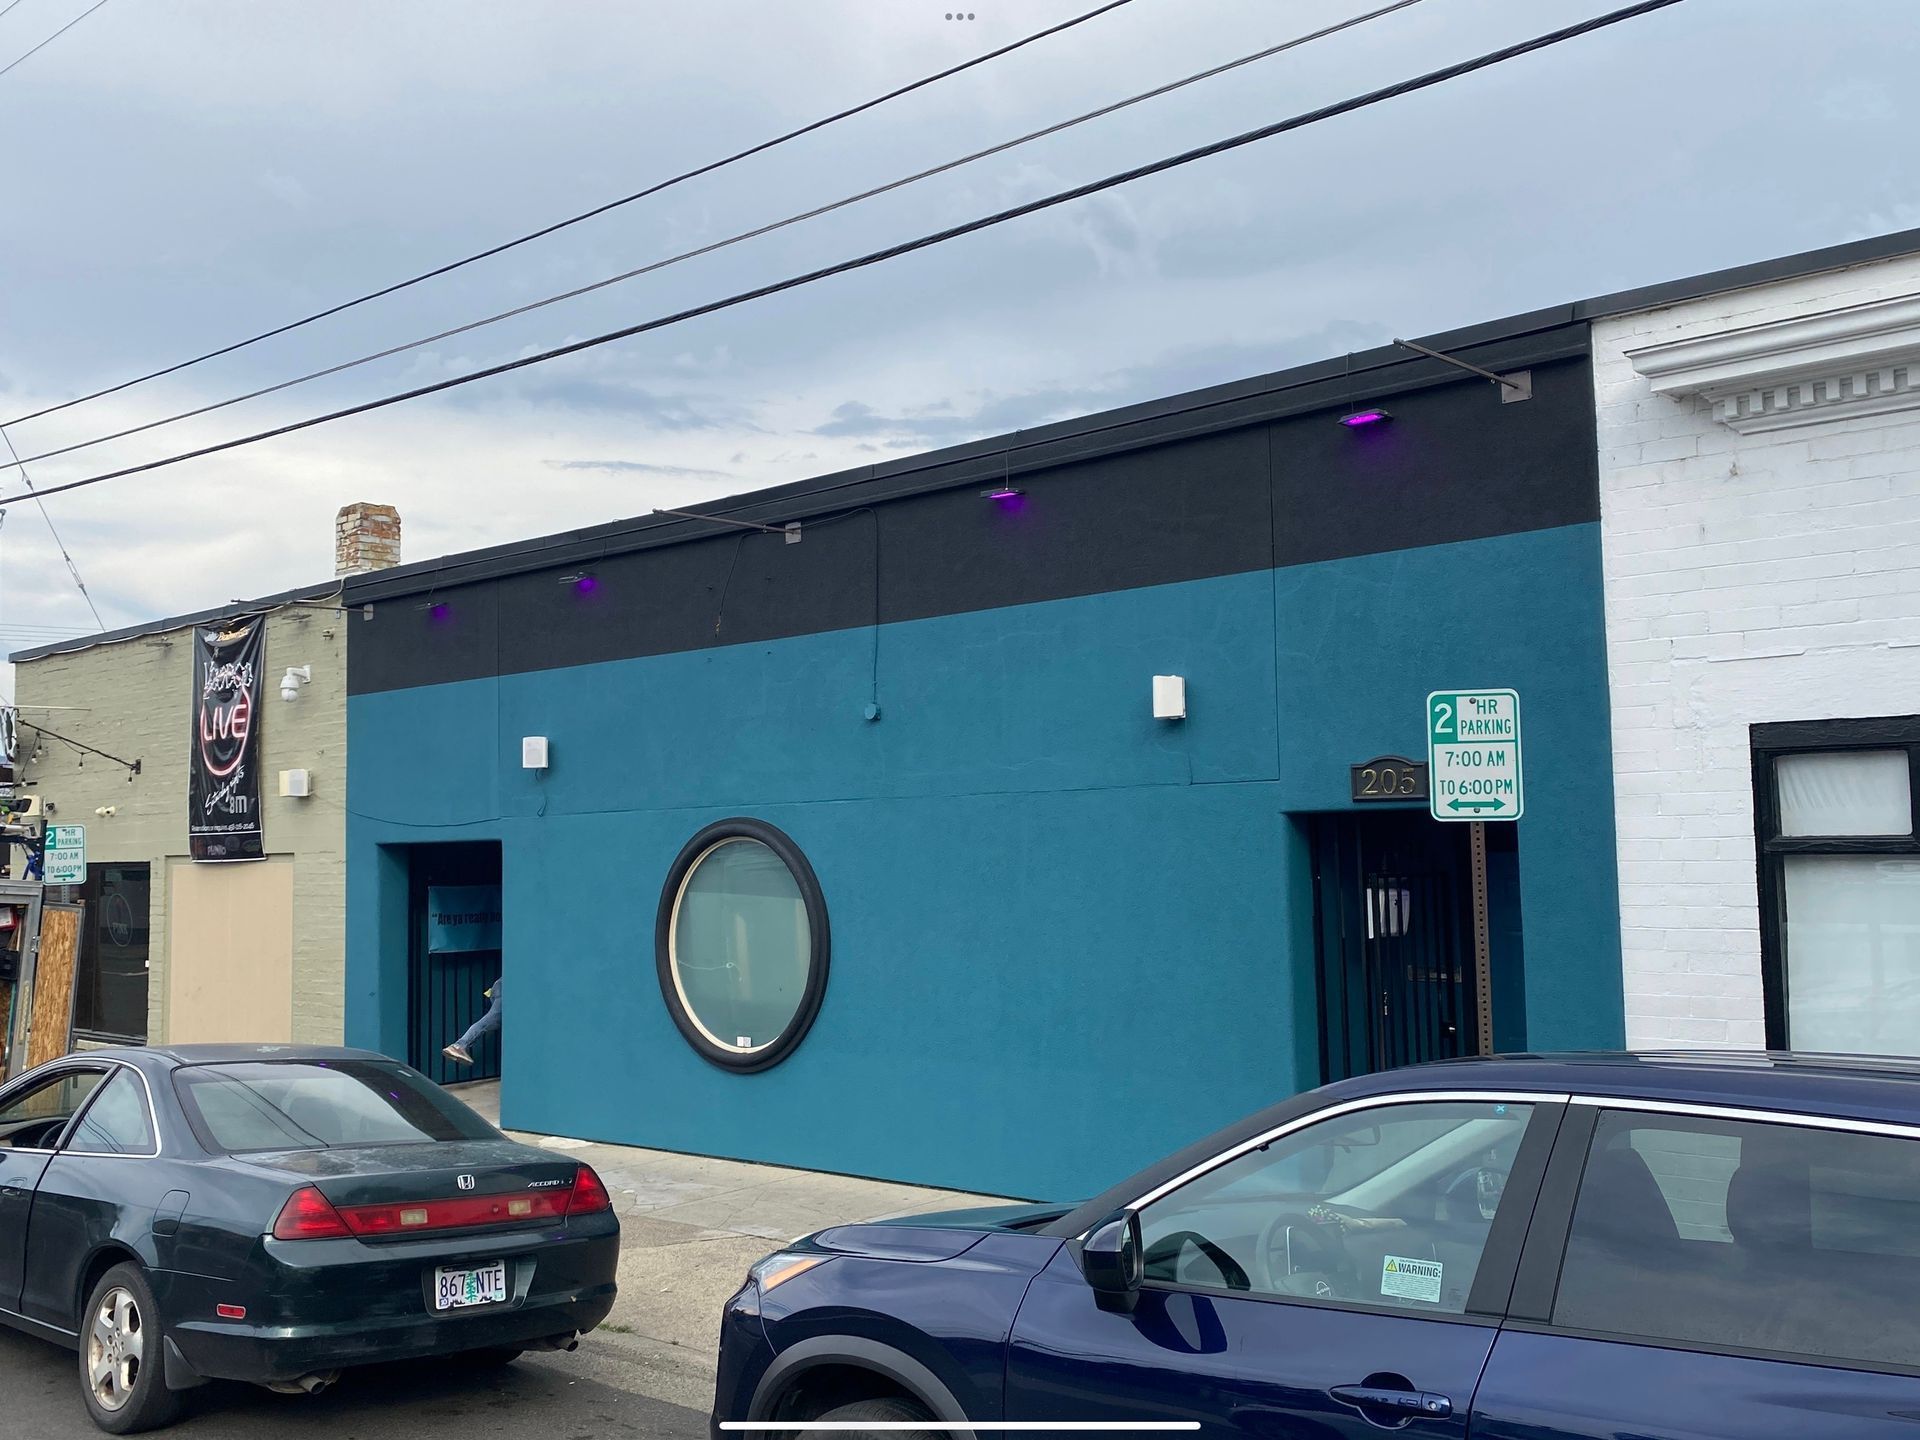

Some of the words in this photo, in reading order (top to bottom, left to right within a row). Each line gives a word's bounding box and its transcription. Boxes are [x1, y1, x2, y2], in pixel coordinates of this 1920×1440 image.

[1476, 699, 1498, 715] HR
[203, 703, 247, 741] LIVE
[1434, 703, 1453, 733] 2
[1460, 718, 1512, 735] PARKING
[1445, 751, 1482, 767] 7:00
[1486, 751, 1506, 767] AM
[1361, 768, 1416, 795] 205
[1440, 780, 1456, 795] TO
[1459, 779, 1493, 795] 6:00
[1495, 779, 1513, 794] PM
[45, 831, 55, 846] 2
[57, 838, 82, 846] PARKING
[50, 852, 68, 861] 7:00
[56, 865, 73, 873] 6:00
[527, 1179, 560, 1188] ACCORD
[1398, 1262, 1441, 1278] WARNING:
[440, 1273, 466, 1298] 867
[475, 1269, 503, 1293] NTE
